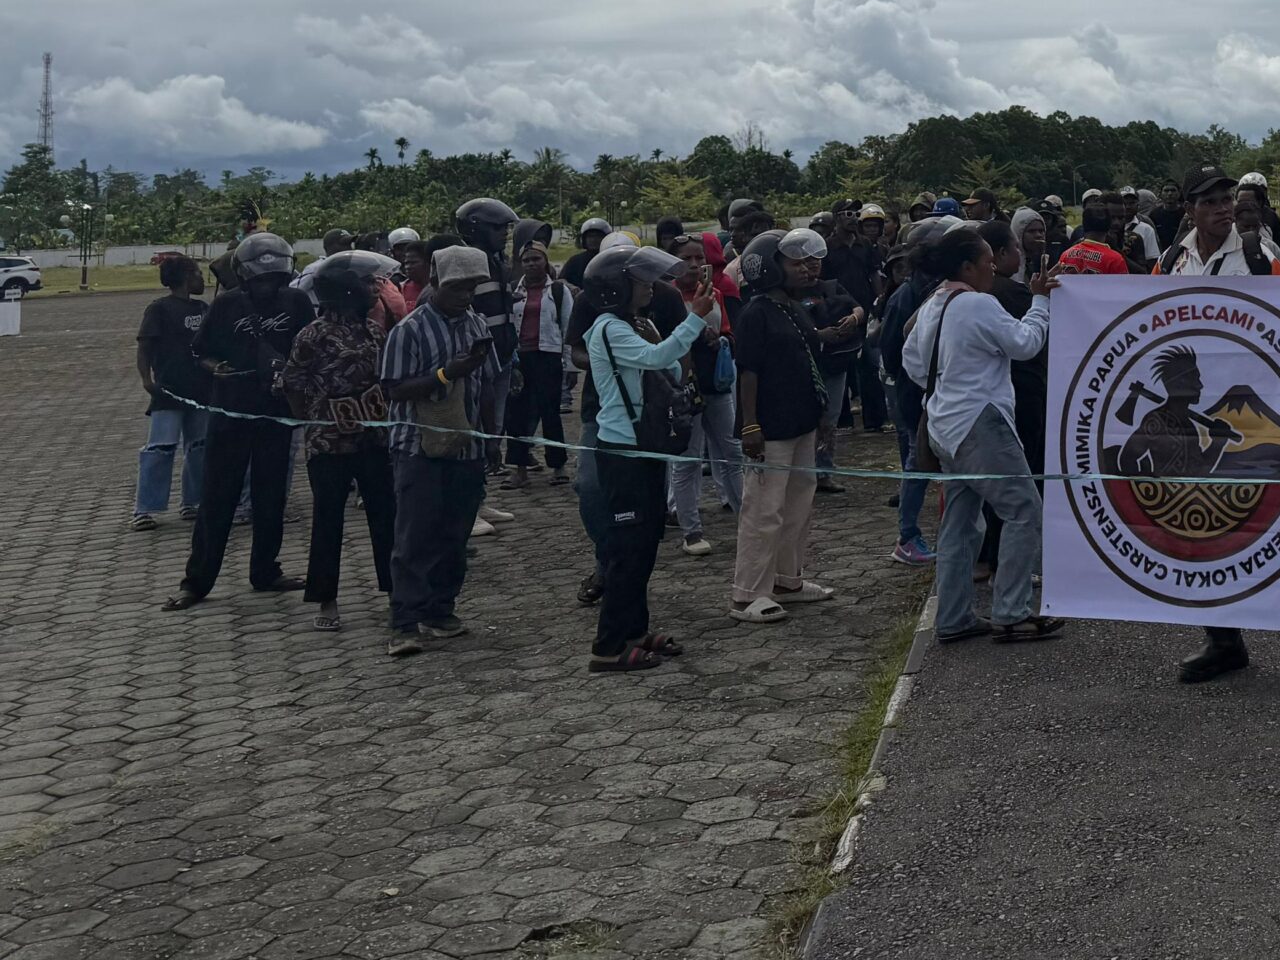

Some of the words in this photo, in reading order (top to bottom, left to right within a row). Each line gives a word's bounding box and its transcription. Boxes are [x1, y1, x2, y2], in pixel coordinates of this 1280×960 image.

[1152, 304, 1255, 332] APELCAMI
[1088, 331, 1140, 394] PAPUA
[1075, 397, 1098, 475] MIMIKA
[1081, 481, 1168, 581] CARSTENSZ
[1172, 565, 1238, 588] LOKAL
